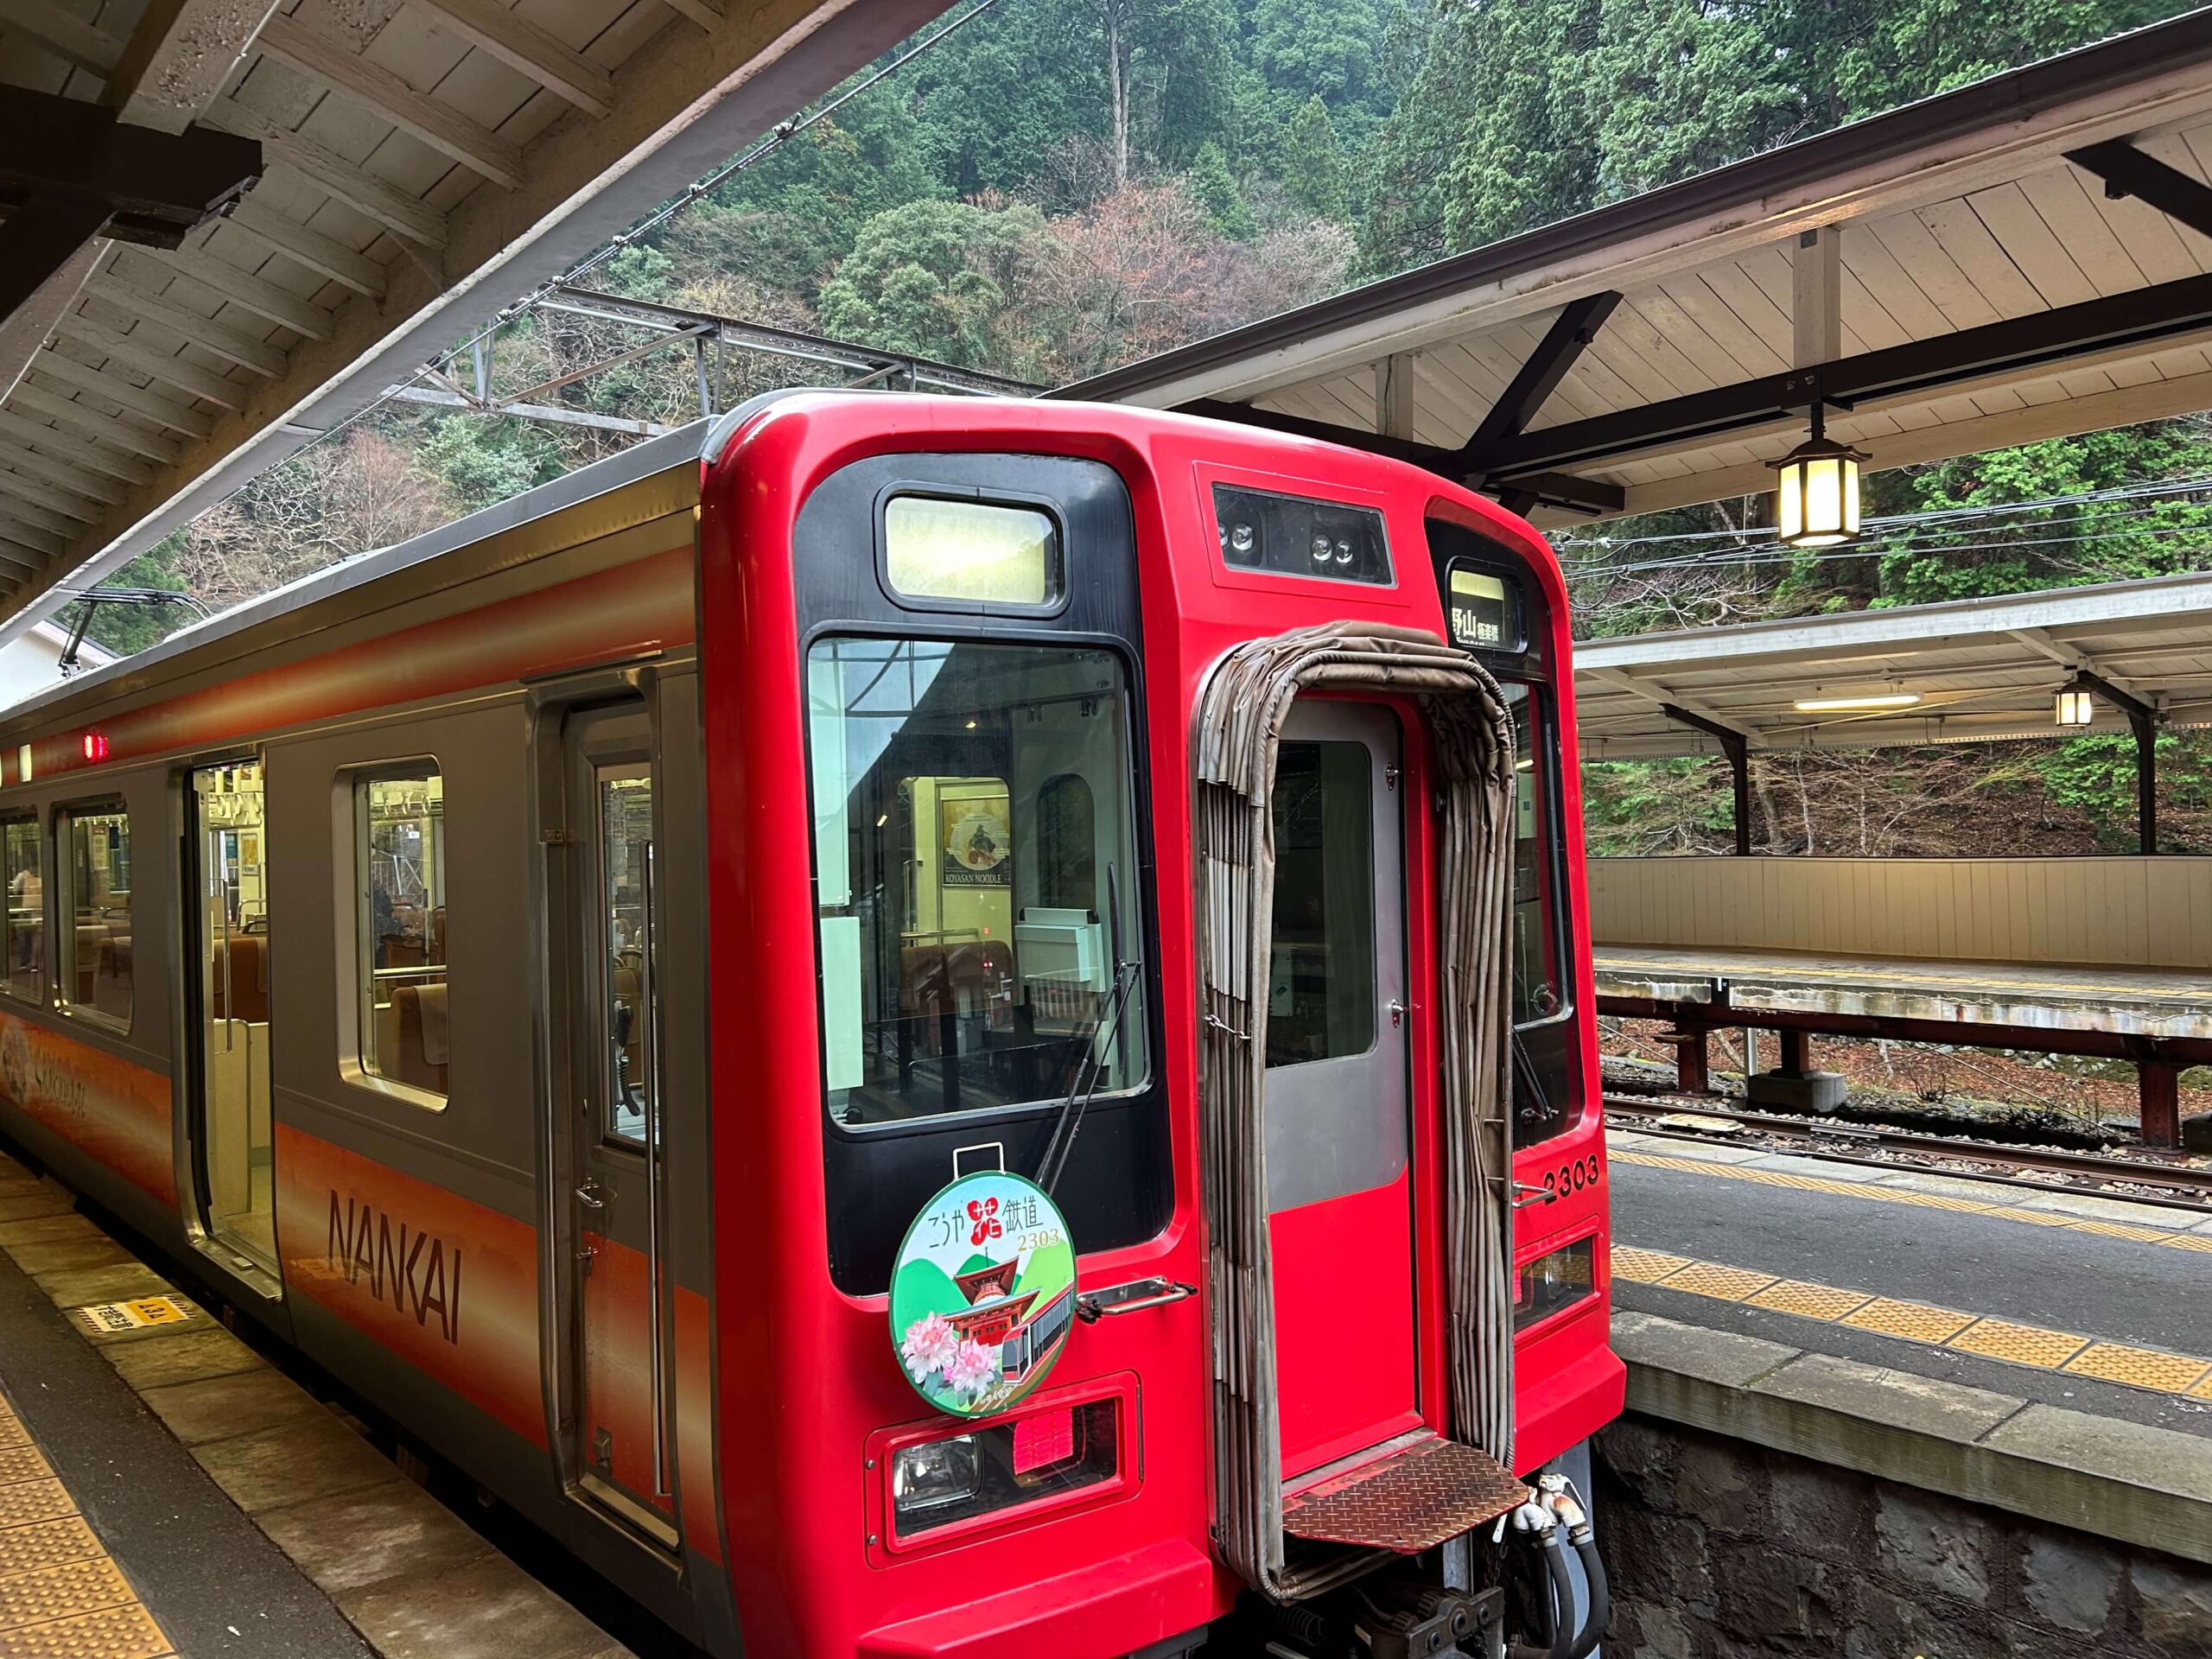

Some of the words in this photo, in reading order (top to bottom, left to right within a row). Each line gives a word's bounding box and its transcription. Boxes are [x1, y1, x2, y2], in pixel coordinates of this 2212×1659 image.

[945, 874, 974, 883] KOYASAN
[975, 874, 1002, 884] NOODLE
[1543, 1154, 1599, 1205] 2303
[1017, 1228, 1060, 1253] 2303
[328, 1189, 461, 1345] NANKAI
